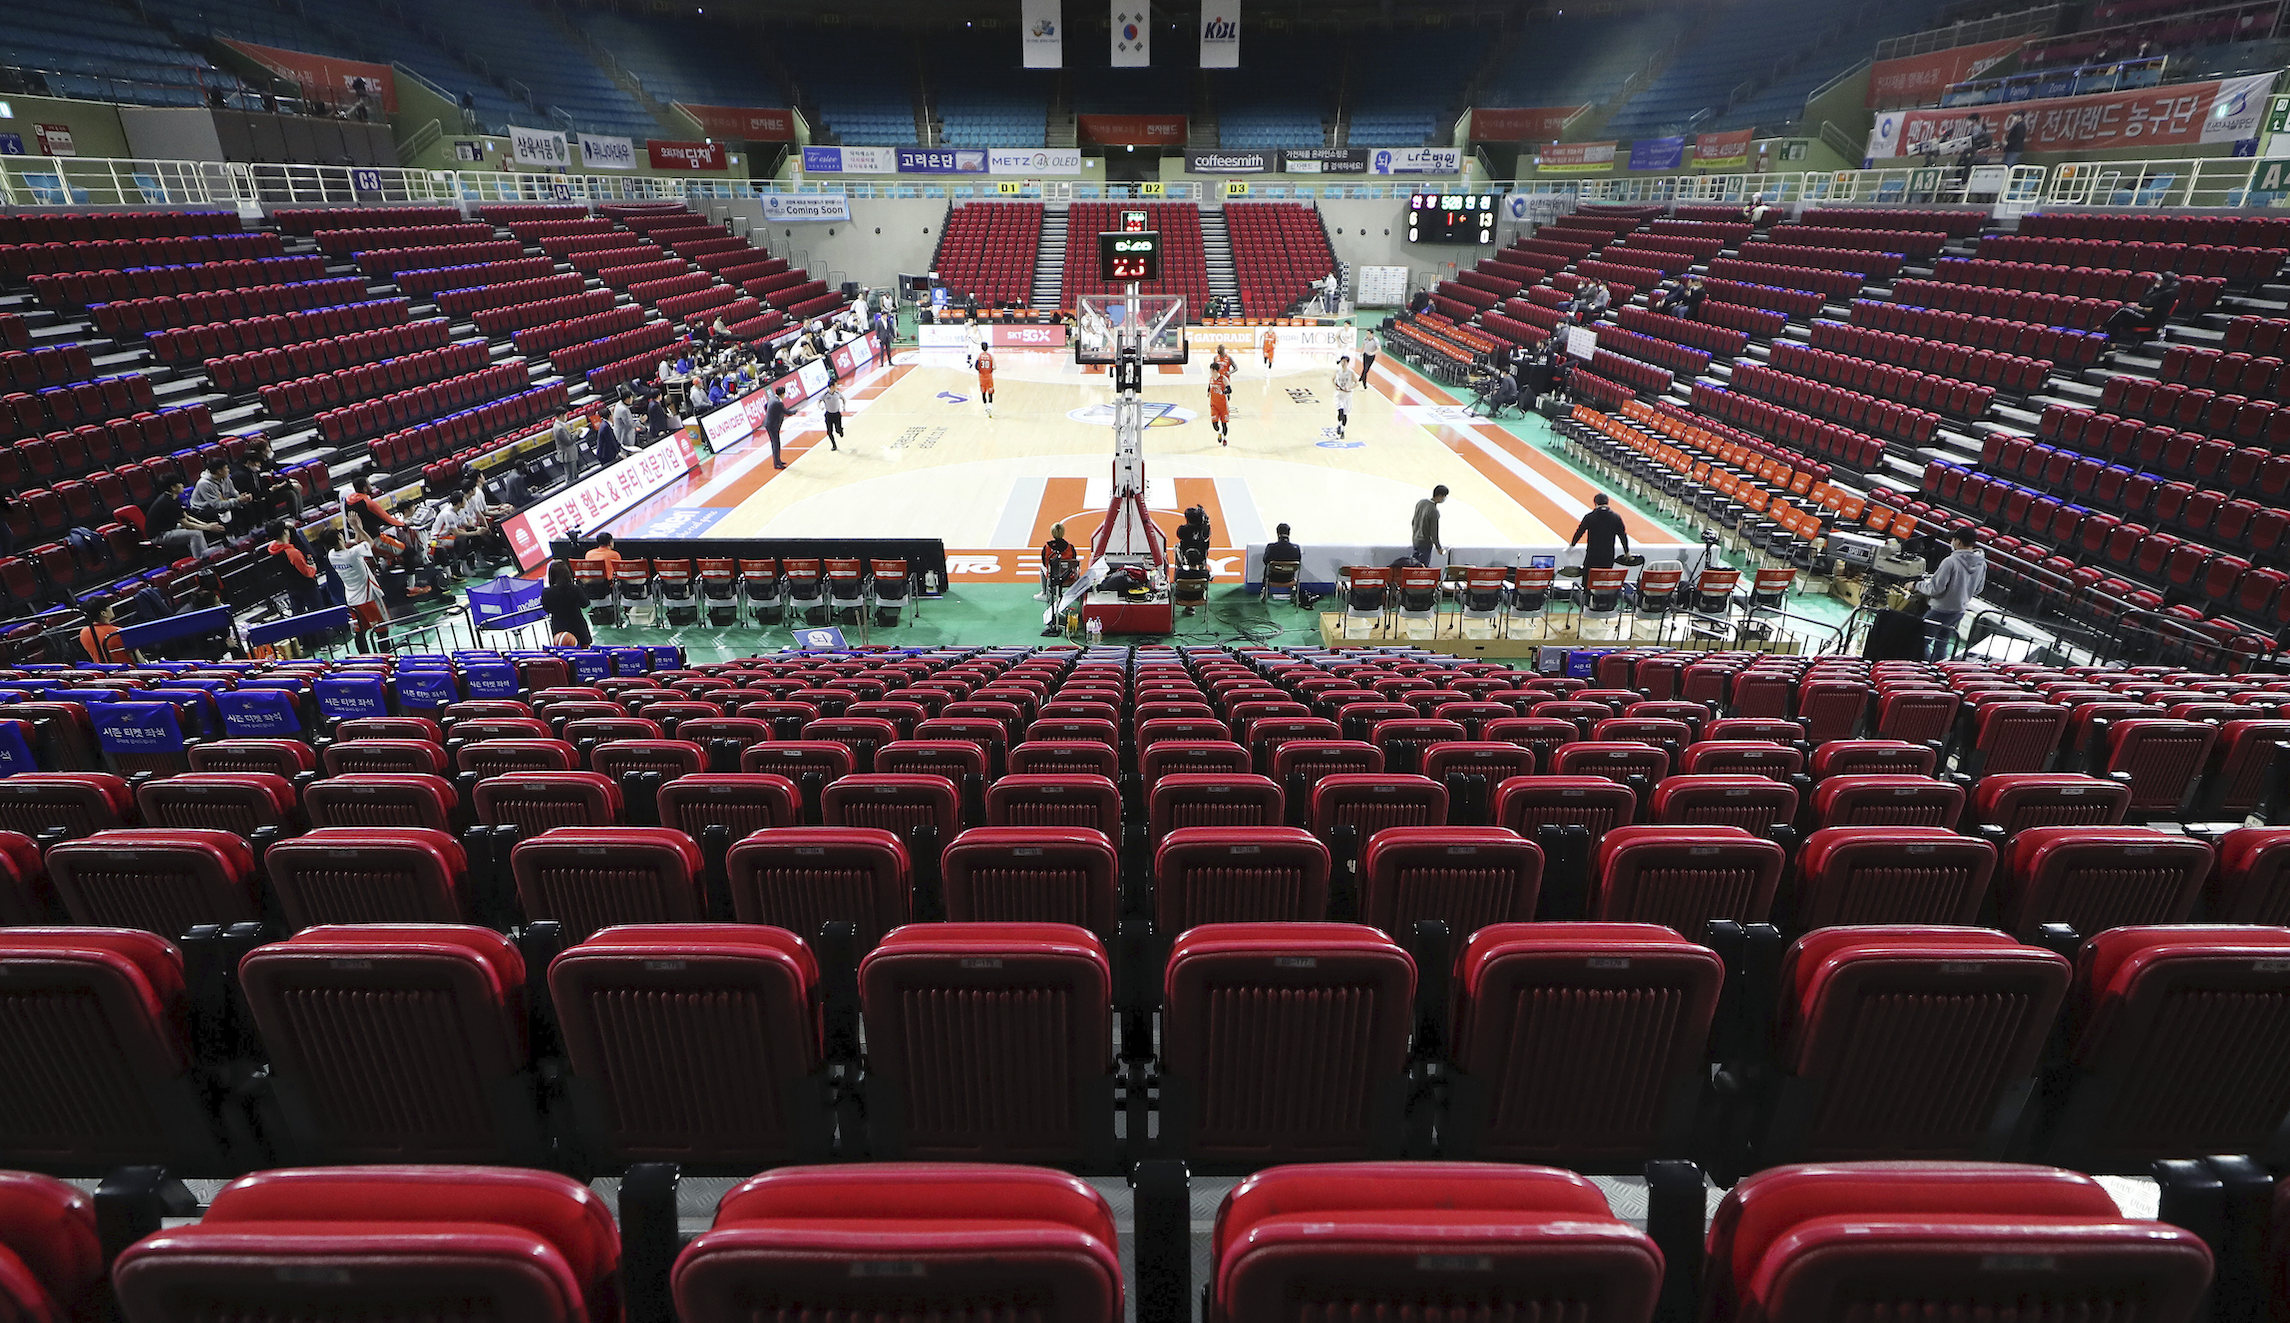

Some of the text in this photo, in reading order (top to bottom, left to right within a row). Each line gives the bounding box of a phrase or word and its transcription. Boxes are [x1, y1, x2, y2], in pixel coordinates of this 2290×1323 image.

[2041, 95, 2200, 142] 전자랜드 농구단
[517, 136, 553, 160] 삼육식품
[592, 145, 630, 163] 위니아대우
[685, 146, 713, 168] 딤채
[902, 153, 954, 168] 고려은단
[992, 157, 1030, 166] METZ
[1052, 156, 1079, 167] OLED
[1195, 154, 1264, 167] coffeesmith
[1408, 148, 1455, 168] 나은병원
[358, 171, 379, 190] C3
[1728, 177, 1742, 192] A2
[1914, 171, 1936, 190] A3
[2261, 164, 2290, 190] A
[556, 186, 570, 199] C4
[786, 206, 819, 215] Coming
[821, 206, 843, 214] Soon
[1479, 212, 1493, 227] 13
[1022, 329, 1051, 342] 5GX
[1196, 333, 1252, 343] GATORADE
[980, 360, 990, 368] 30
[708, 413, 745, 440] SUNRIDER
[580, 491, 609, 518] 헬스
[606, 481, 621, 502] &
[617, 467, 643, 498] 뷰티
[640, 445, 680, 484] 전문기업
[402, 689, 416, 698] 시즌
[416, 690, 430, 699] 티켓
[324, 698, 375, 707] 시즌 티켓 좌석
[227, 714, 245, 723] 시즌
[244, 714, 263, 722] 티켓
[103, 727, 166, 738] 시즌 티켓 좌석
